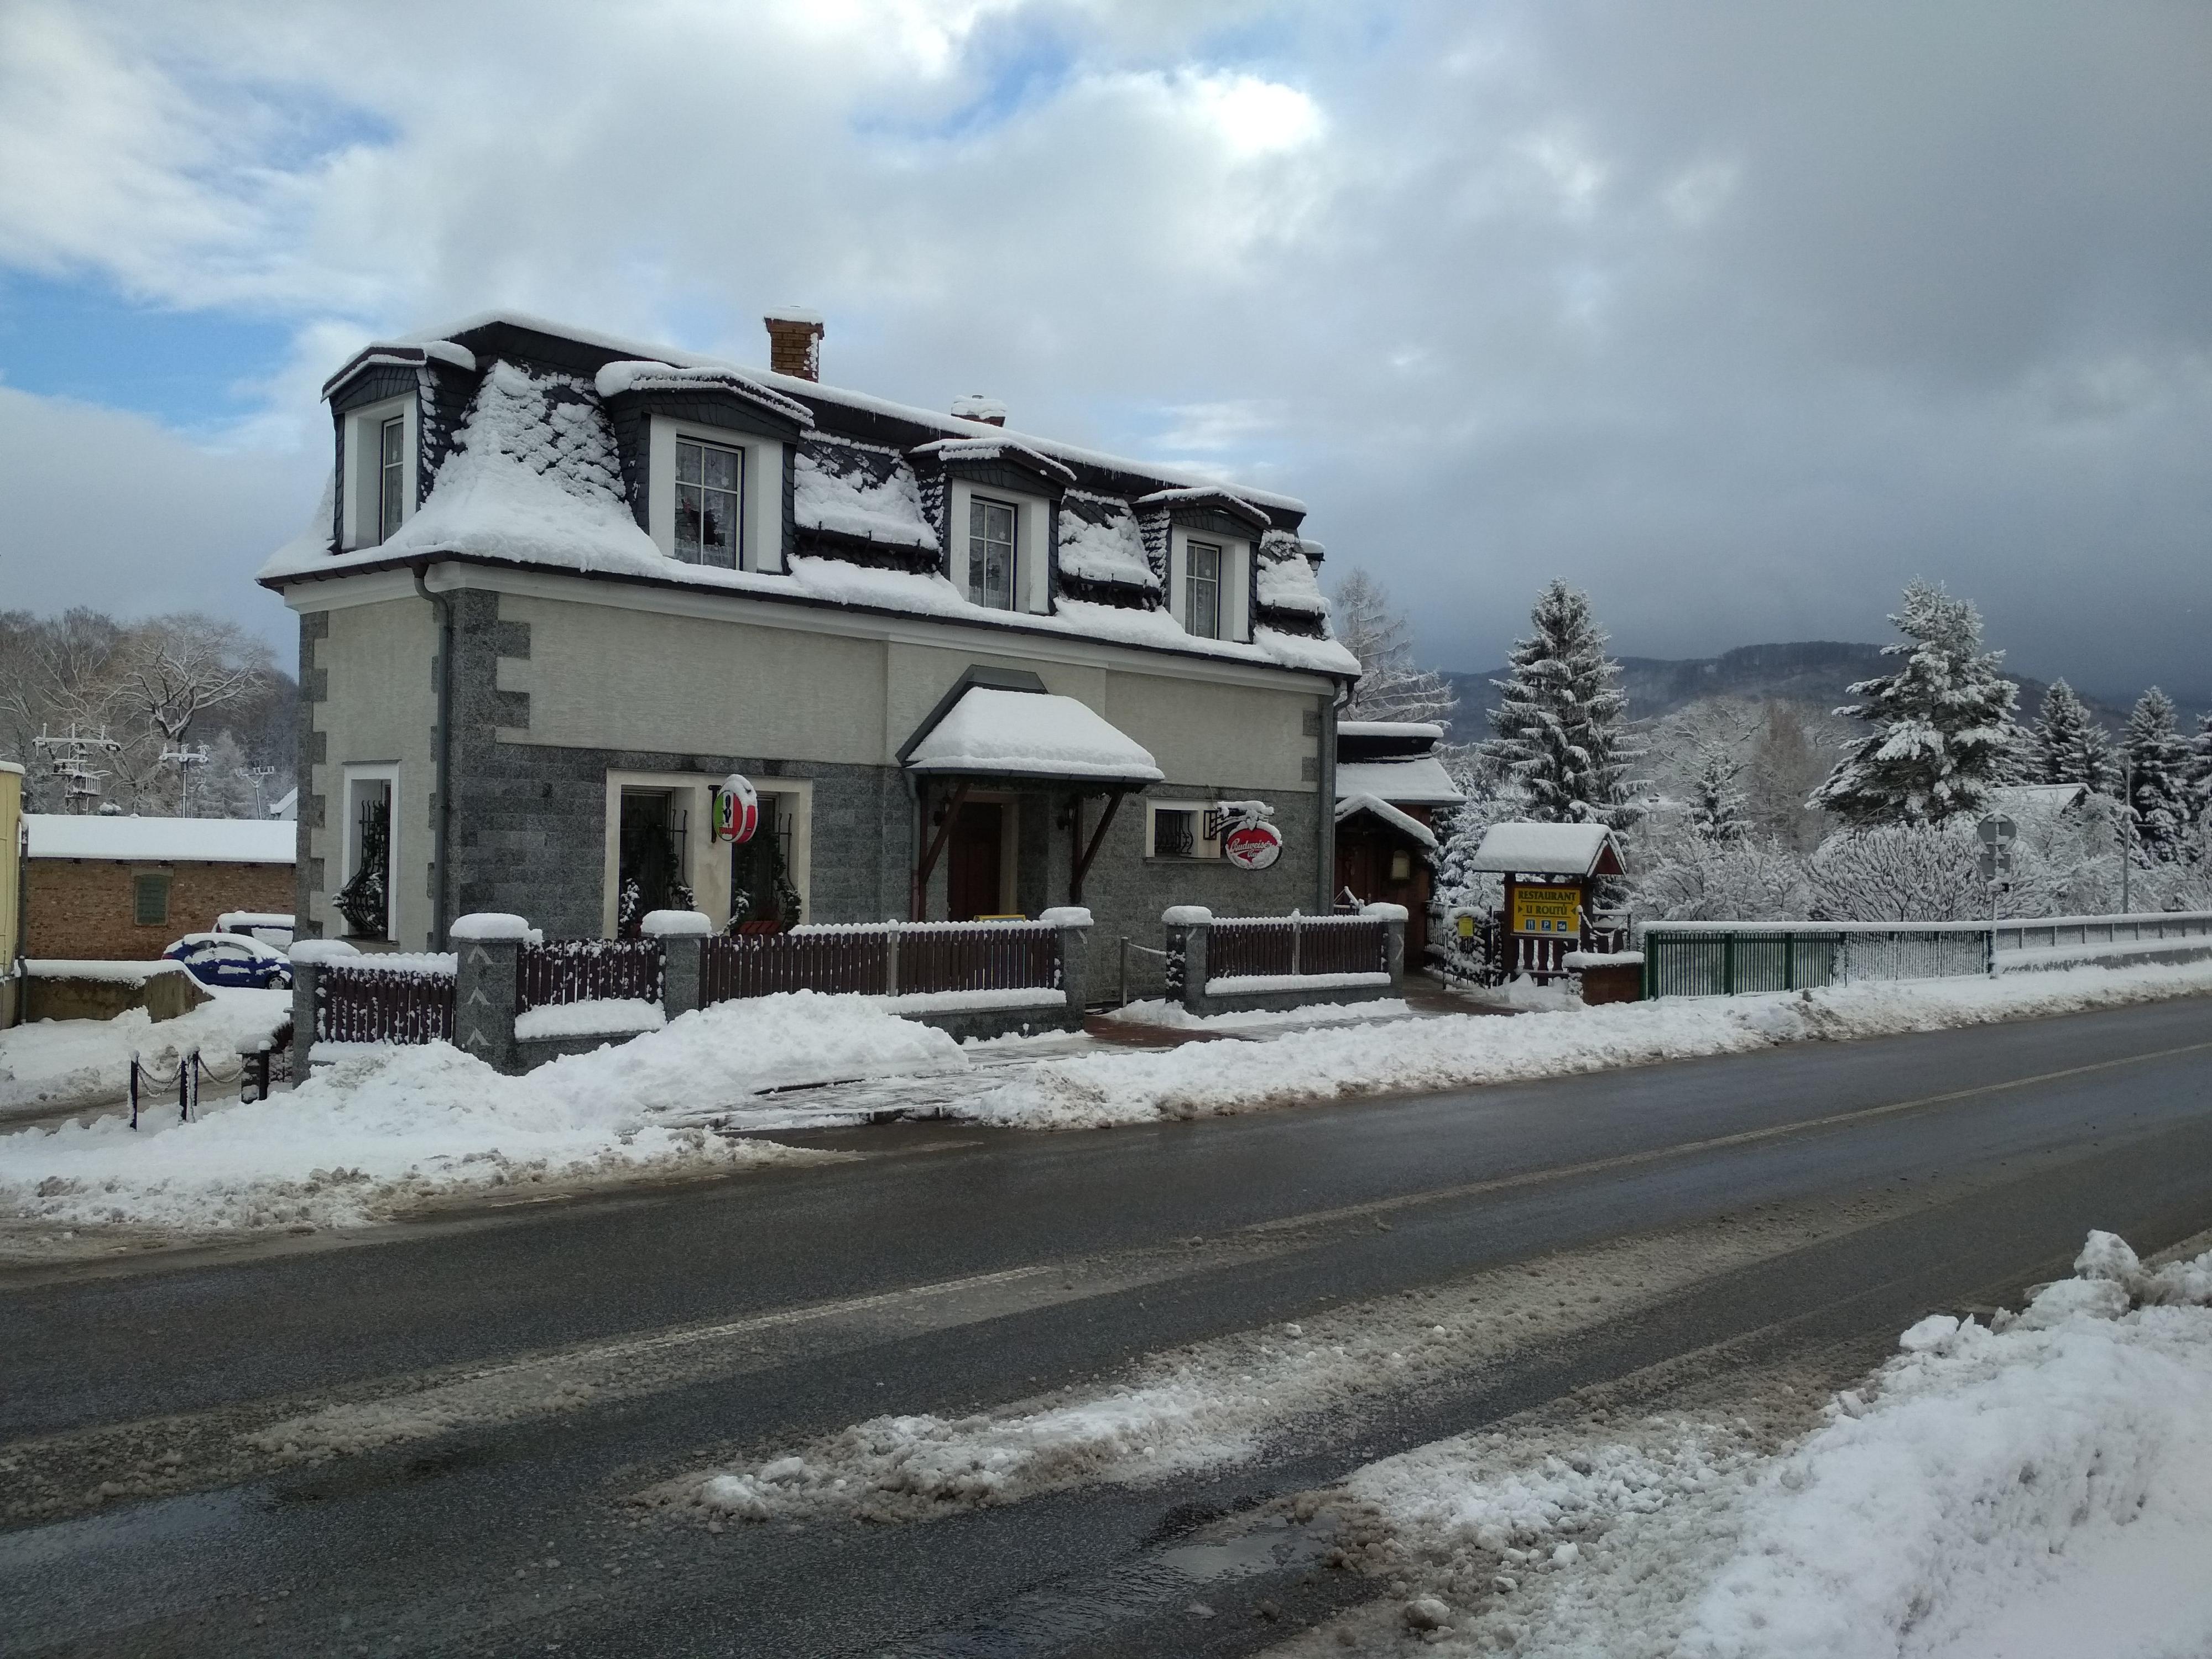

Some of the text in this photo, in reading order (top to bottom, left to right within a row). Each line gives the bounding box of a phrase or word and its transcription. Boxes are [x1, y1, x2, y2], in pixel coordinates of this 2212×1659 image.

[1230, 838, 1272, 854] Budweiser
[1518, 890, 1576, 901] RESTAURANT
[1526, 905, 1533, 914] U
